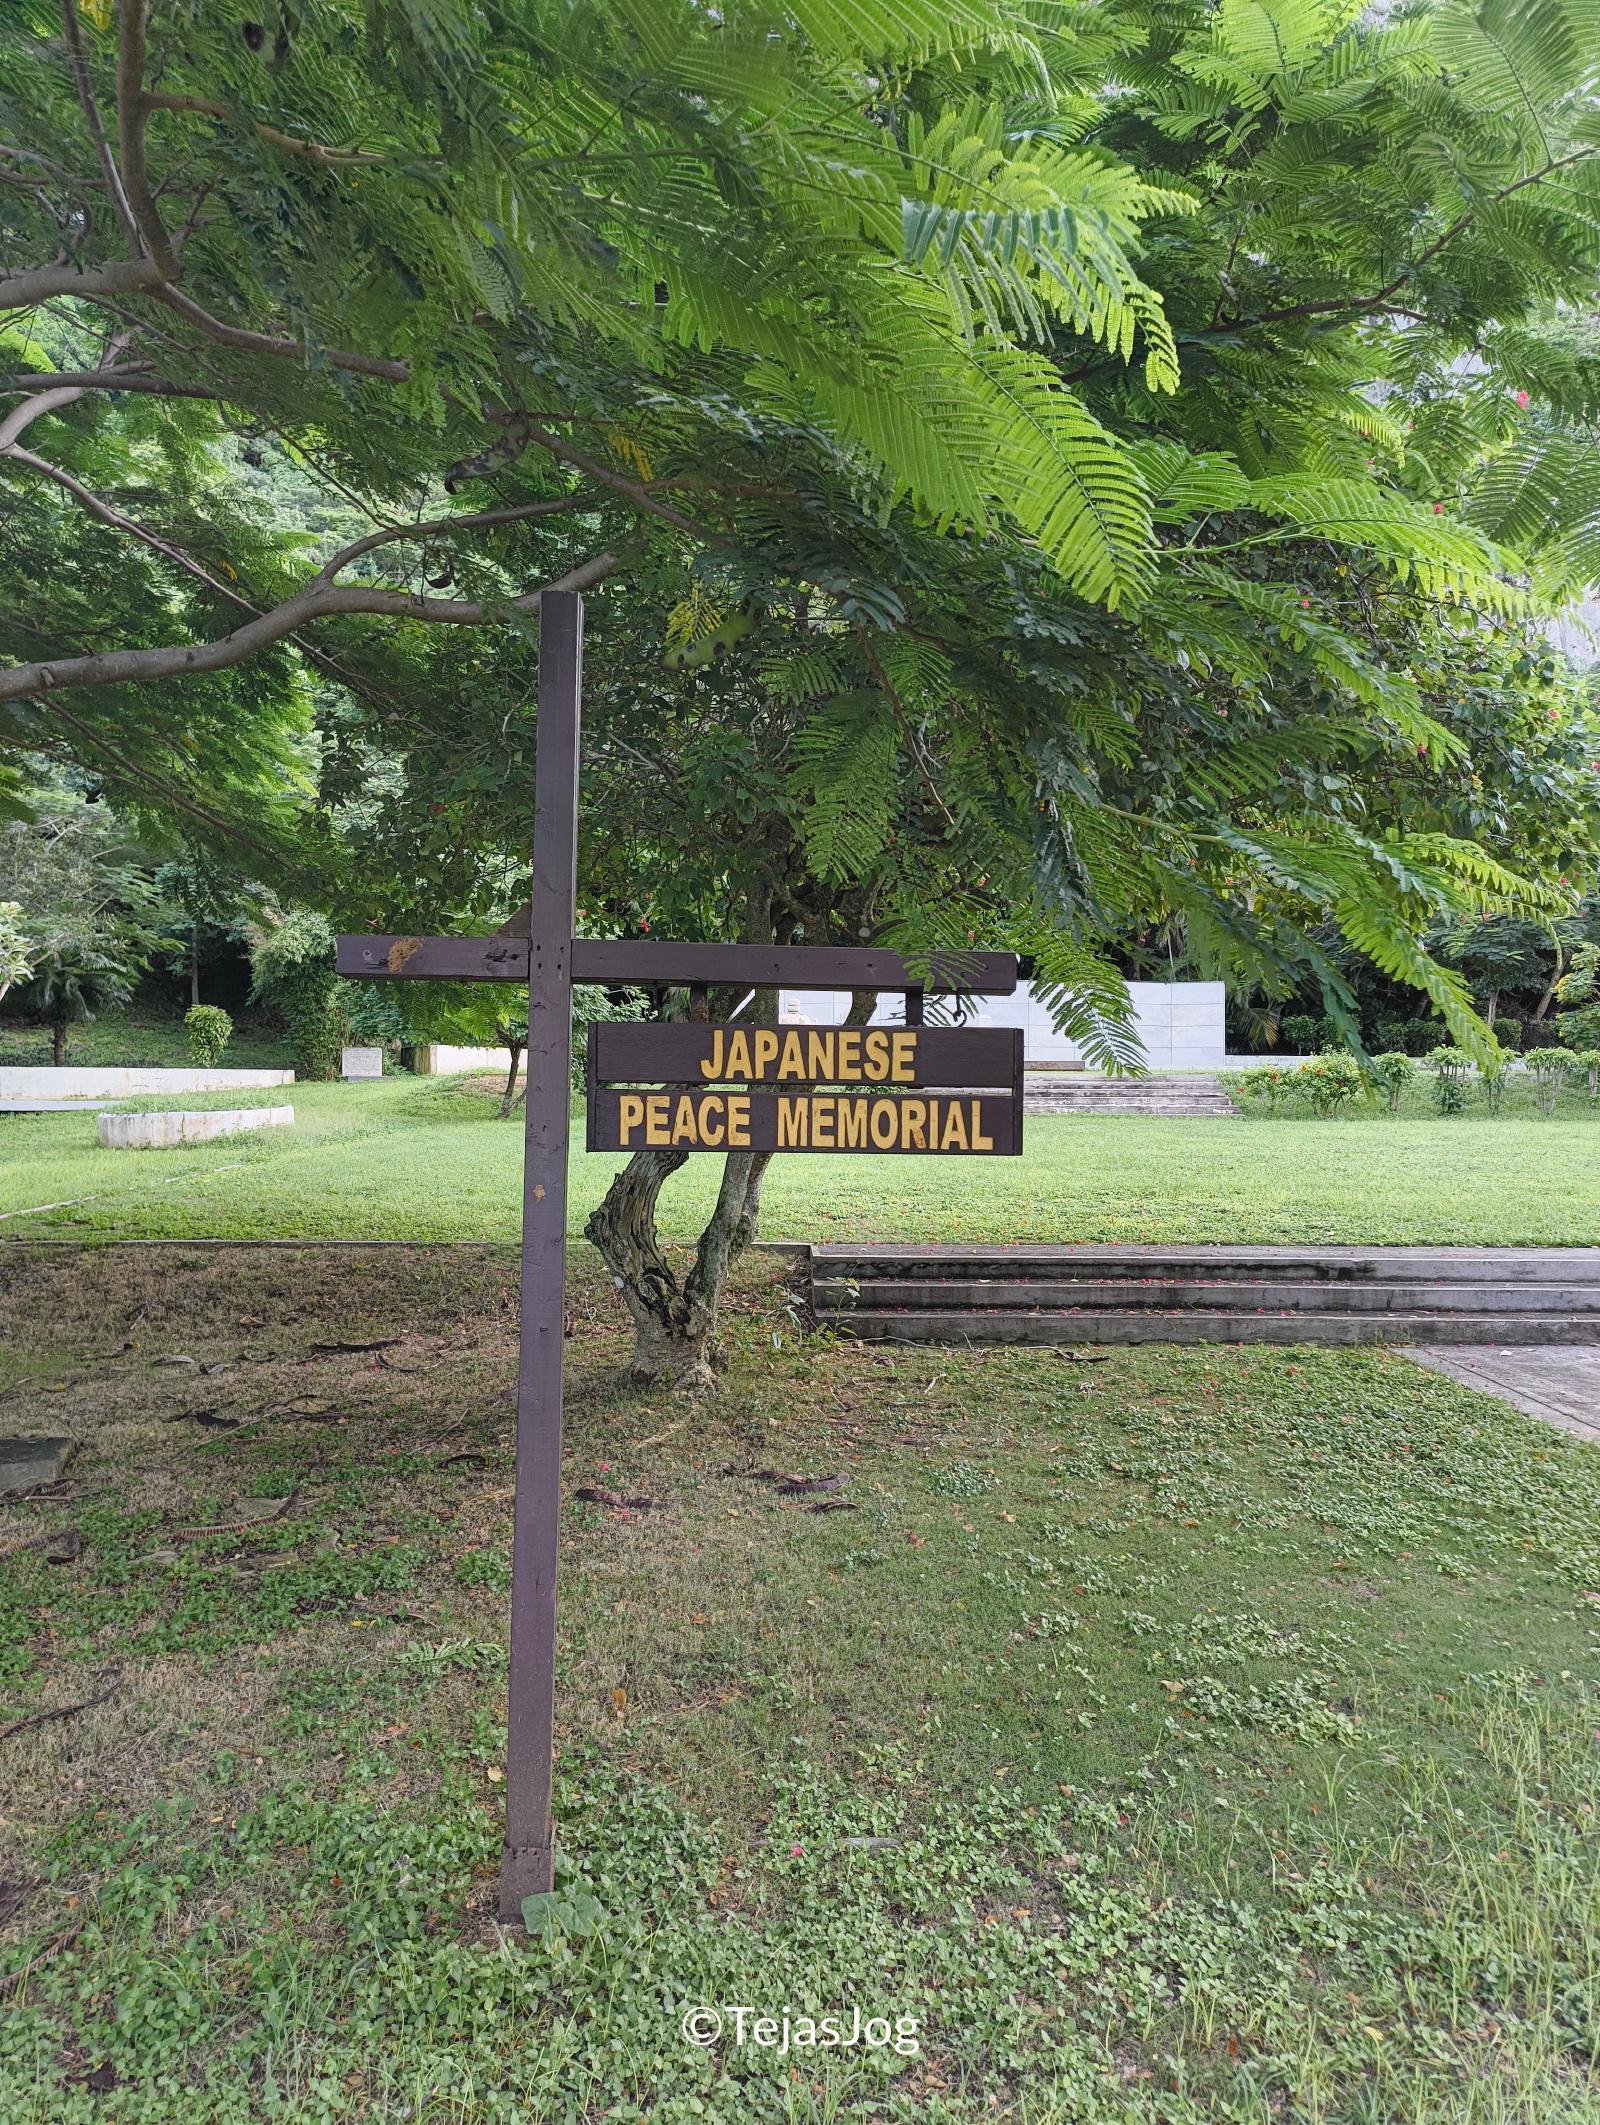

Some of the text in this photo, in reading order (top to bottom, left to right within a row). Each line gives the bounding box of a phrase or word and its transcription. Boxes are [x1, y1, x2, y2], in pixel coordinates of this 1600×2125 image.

[700, 1029, 918, 1082] JAPANESE
[619, 1095, 994, 1151] PEACE MEMORIAL
